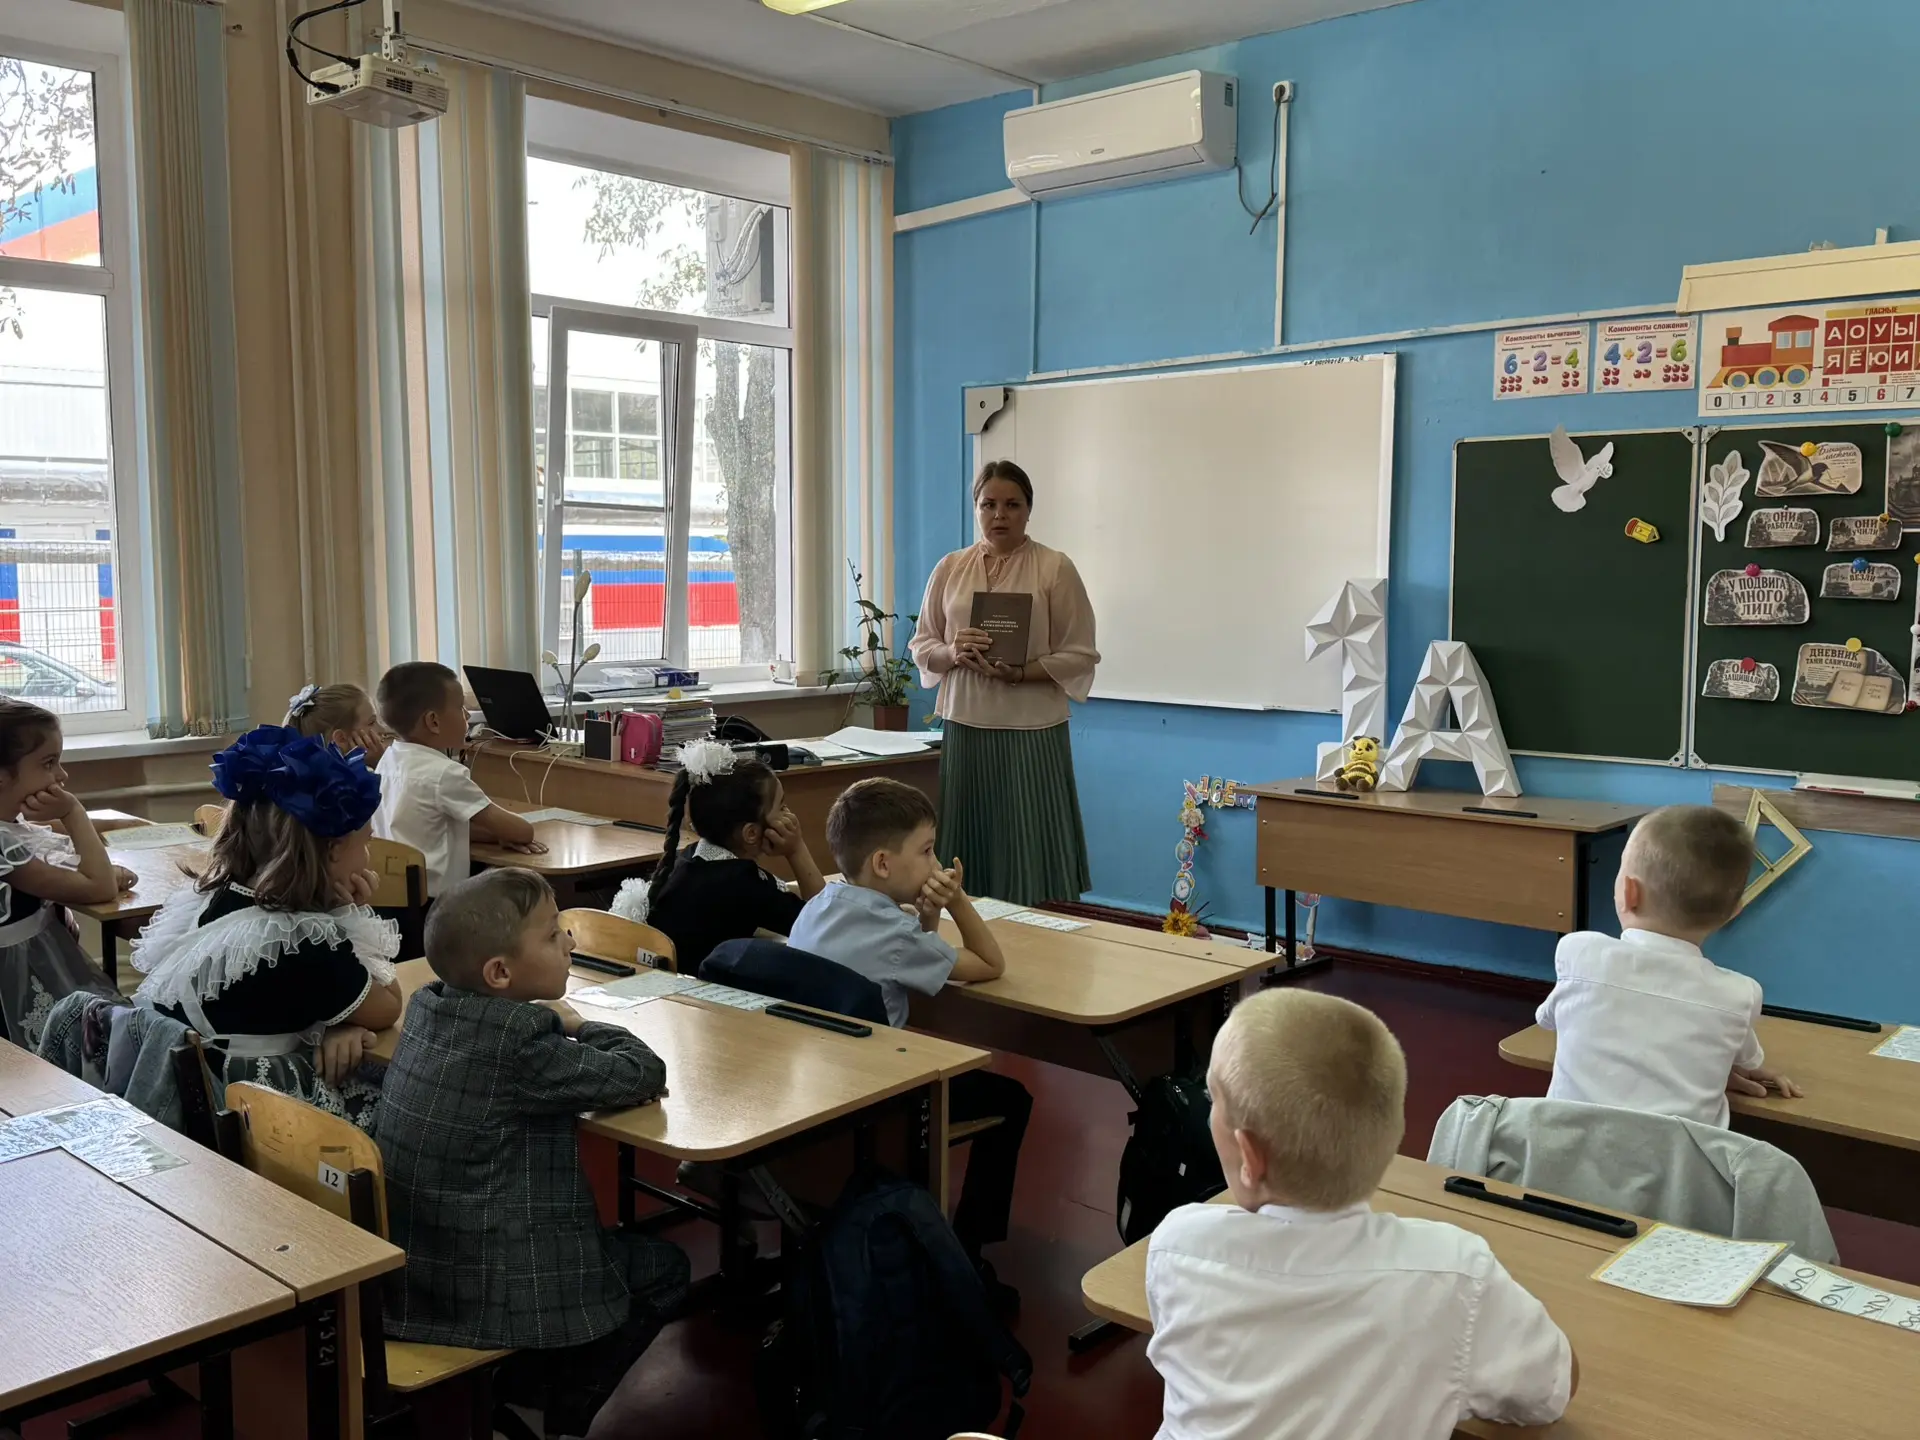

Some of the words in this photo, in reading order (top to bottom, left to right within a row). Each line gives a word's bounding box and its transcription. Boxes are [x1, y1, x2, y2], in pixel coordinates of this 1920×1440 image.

[1864, 305, 1899, 316] ГЛАСНЫЕ
[1607, 323, 1652, 334] Компоненты
[1652, 322, 1689, 330] сложения
[1827, 326, 1843, 341] А
[1849, 324, 1865, 339] О
[1873, 322, 1888, 338] У
[1893, 321, 1914, 337] Ы
[1506, 333, 1546, 344] Компоненты
[1547, 329, 1581, 340] вычитания
[1604, 342, 1621, 366] 4
[1636, 340, 1653, 364] 2
[1670, 338, 1687, 362] 6
[1503, 353, 1518, 375] 6
[1533, 350, 1548, 372] 2
[1564, 347, 1580, 369] 4
[1827, 354, 1841, 368] Я
[1849, 350, 1862, 367] Ё
[1868, 351, 1889, 366] Ю
[1894, 350, 1910, 365] И
[1713, 395, 1723, 408] 0
[1740, 395, 1747, 406] 1
[1766, 393, 1775, 405] 2
[1792, 392, 1801, 404] 3
[1820, 390, 1829, 402] 4
[1848, 389, 1857, 401] 5
[1876, 388, 1886, 400] 6
[1906, 387, 1915, 399] 7
[1772, 511, 1798, 522] ОНИ
[1765, 521, 1805, 531] РАБОТАЛИ
[1854, 519, 1878, 529] ОНИ
[1851, 528, 1879, 536] УЧИЛИ
[1728, 580, 1737, 593] У
[1739, 576, 1787, 590] ПОДВИГА
[1734, 589, 1785, 605] МНОГО
[1740, 604, 1774, 616] ЛИЦ
[1809, 648, 1859, 661] ДНЕВНИК
[1824, 659, 1862, 670] САВИЧЕВОЙ
[1723, 673, 1764, 686] ЗАЩИЩАЛИ
[642, 952, 653, 965] 12
[324, 1169, 339, 1187] 12
